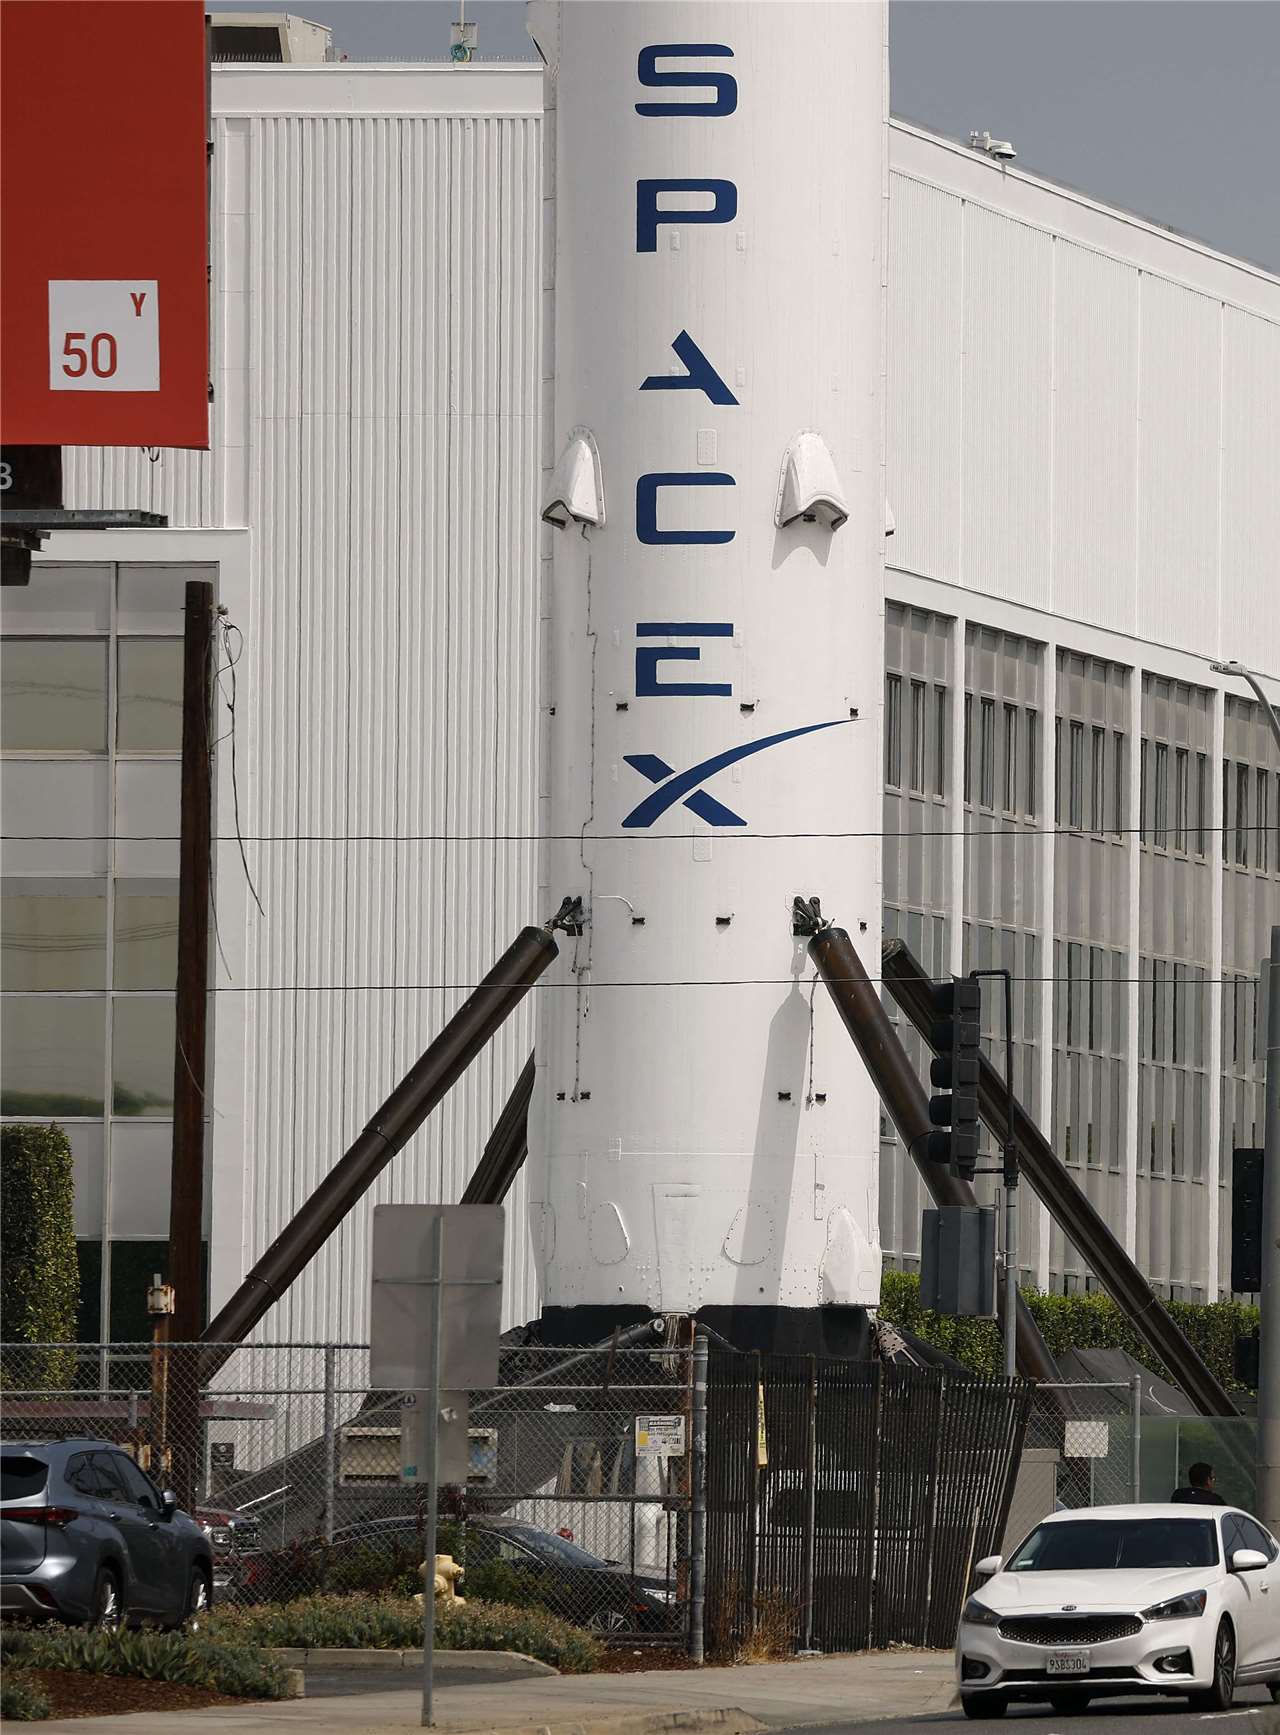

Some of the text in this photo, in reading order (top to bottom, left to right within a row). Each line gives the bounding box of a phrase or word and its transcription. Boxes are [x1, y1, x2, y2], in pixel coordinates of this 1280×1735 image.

[130, 292, 146, 317] Y
[62, 332, 117, 378] 50
[621, 43, 866, 827] SPACEX
